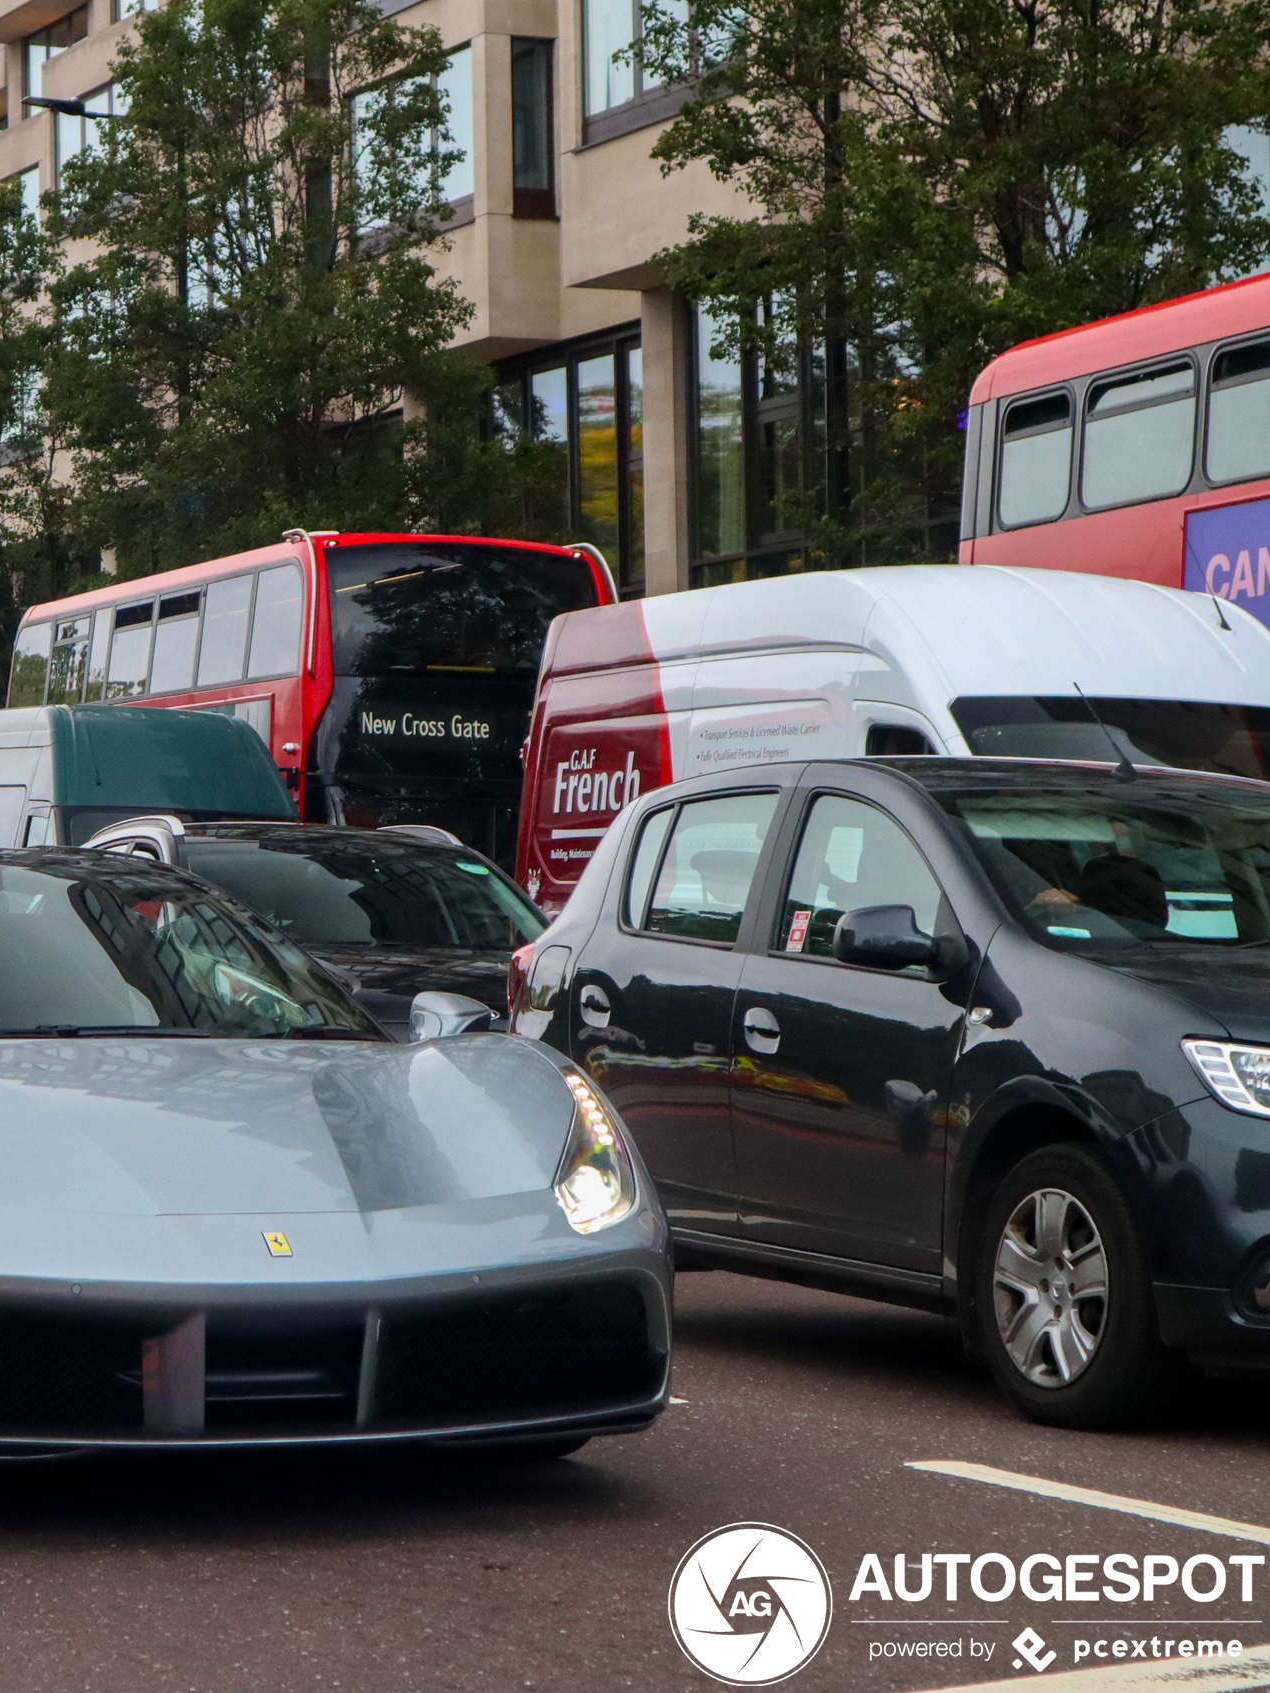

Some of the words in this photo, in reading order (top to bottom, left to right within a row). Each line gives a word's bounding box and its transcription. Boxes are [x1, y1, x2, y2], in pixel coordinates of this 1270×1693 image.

[362, 711, 396, 735] New
[402, 713, 446, 737] Cross
[451, 715, 490, 739] Gate
[704, 729, 728, 743] Transport
[729, 727, 749, 739] Services
[750, 727, 755, 738] &
[756, 724, 780, 737] Licensed
[781, 724, 799, 735] Waste
[800, 723, 821, 735] Carrier
[700, 750, 713, 763] Fully
[714, 748, 737, 763] Qualified
[738, 747, 762, 760] Electrical
[763, 747, 790, 761] Engineers
[553, 751, 641, 814] French
